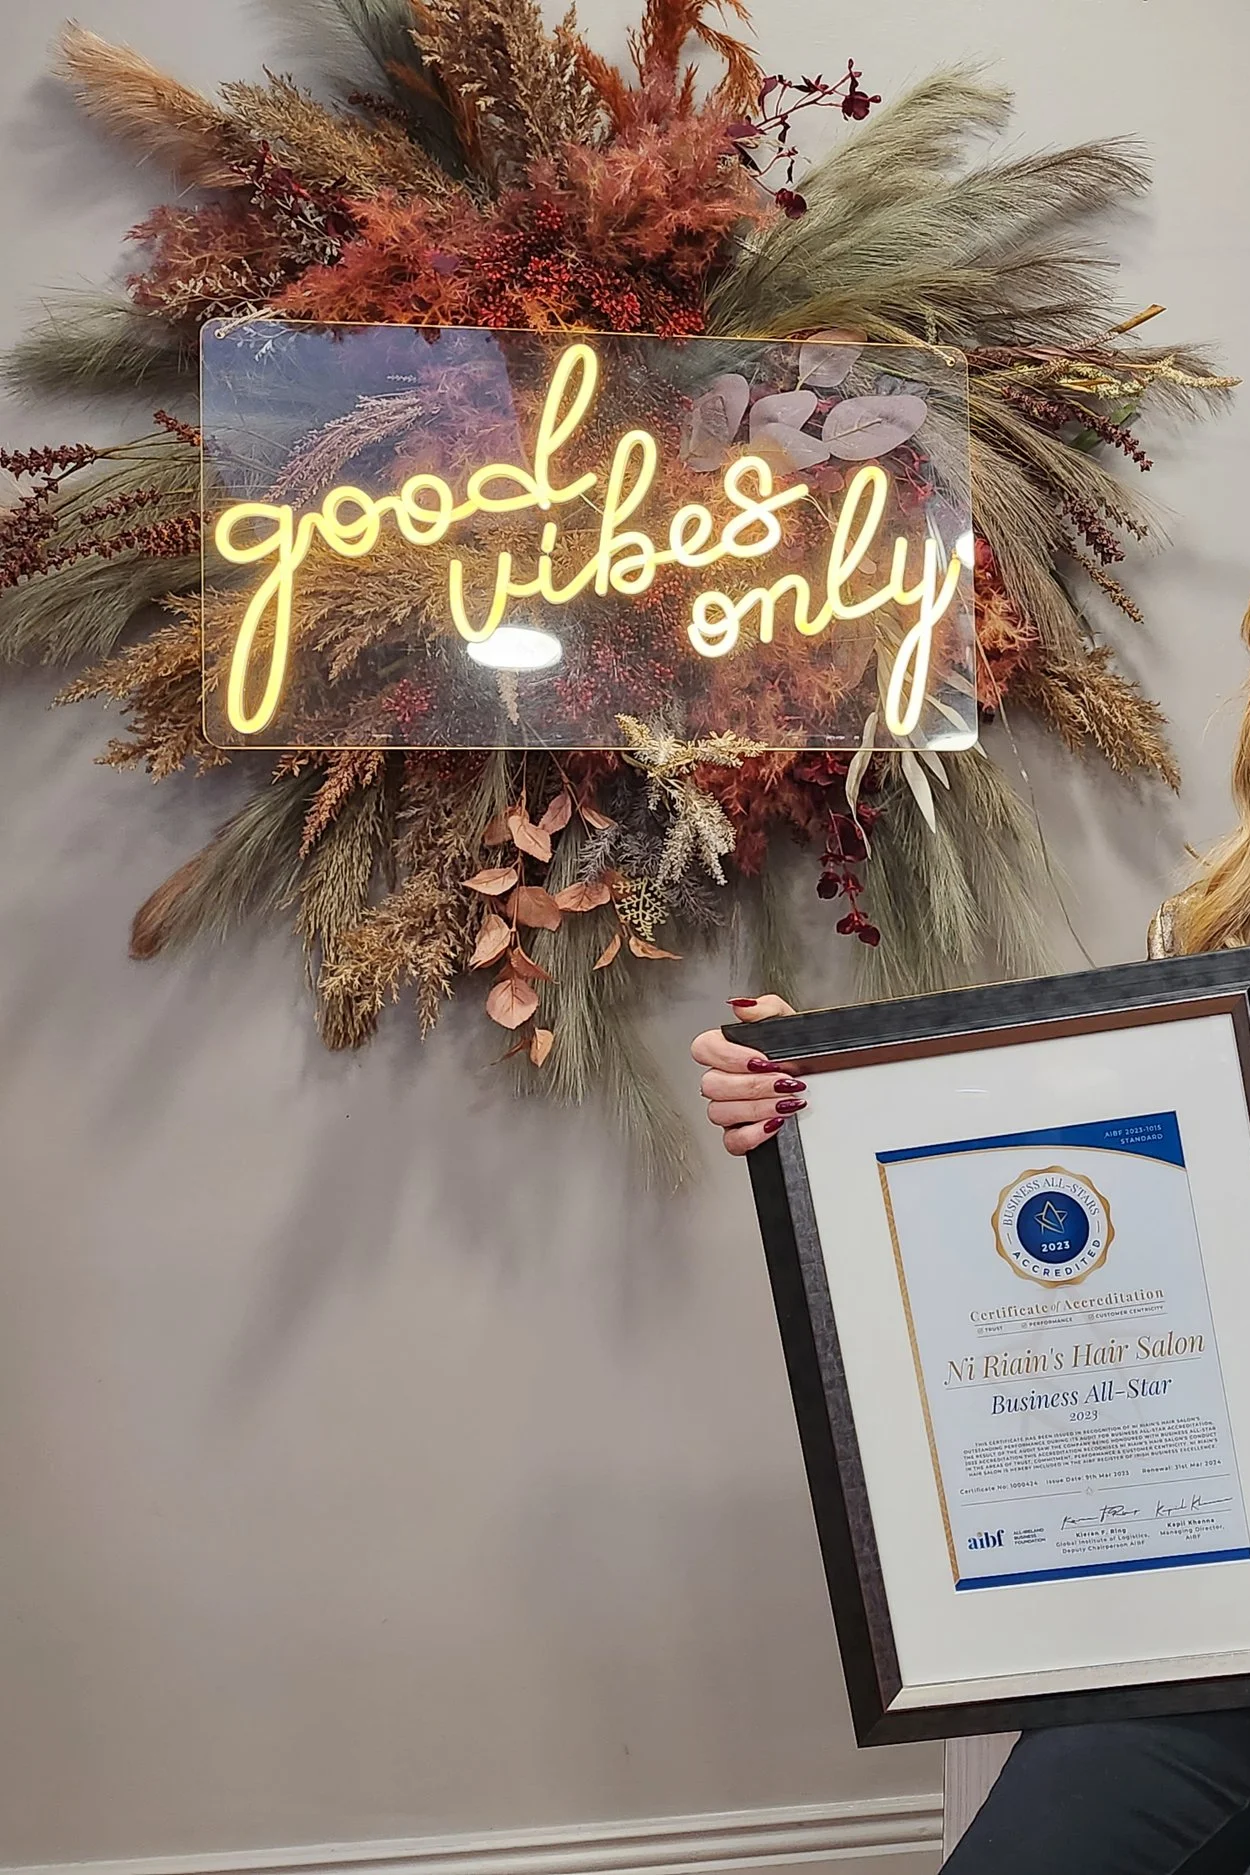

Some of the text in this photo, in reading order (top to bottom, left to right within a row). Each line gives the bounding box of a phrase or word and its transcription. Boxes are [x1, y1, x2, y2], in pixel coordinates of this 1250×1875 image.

[215, 343, 597, 735] good
[450, 430, 808, 643] vibes
[688, 466, 962, 736] only
[1104, 1124, 1162, 1138] AIBF 2023-1015
[1120, 1133, 1163, 1144] STANDARD
[1003, 1177, 1100, 1226] BUSINESS ALL-STARS
[1012, 1239, 1101, 1277] ACCREDITED
[1041, 1240, 1070, 1252] 2023
[970, 1288, 1164, 1322] Certificate of Accreditation
[1029, 1317, 1073, 1327] PERFORMANCE
[1095, 1310, 1128, 1319] CUSTOMER
[1128, 1305, 1163, 1314] CENTRICITY
[944, 1330, 1205, 1386] Ni Riain's Hair Salon
[991, 1378, 1172, 1415] Business All-Star
[1069, 1409, 1098, 1422] 2023
[967, 1529, 1005, 1550] aibf
[1014, 1537, 1046, 1545] FOUNDATION
[1159, 1528, 1193, 1536] Managing
